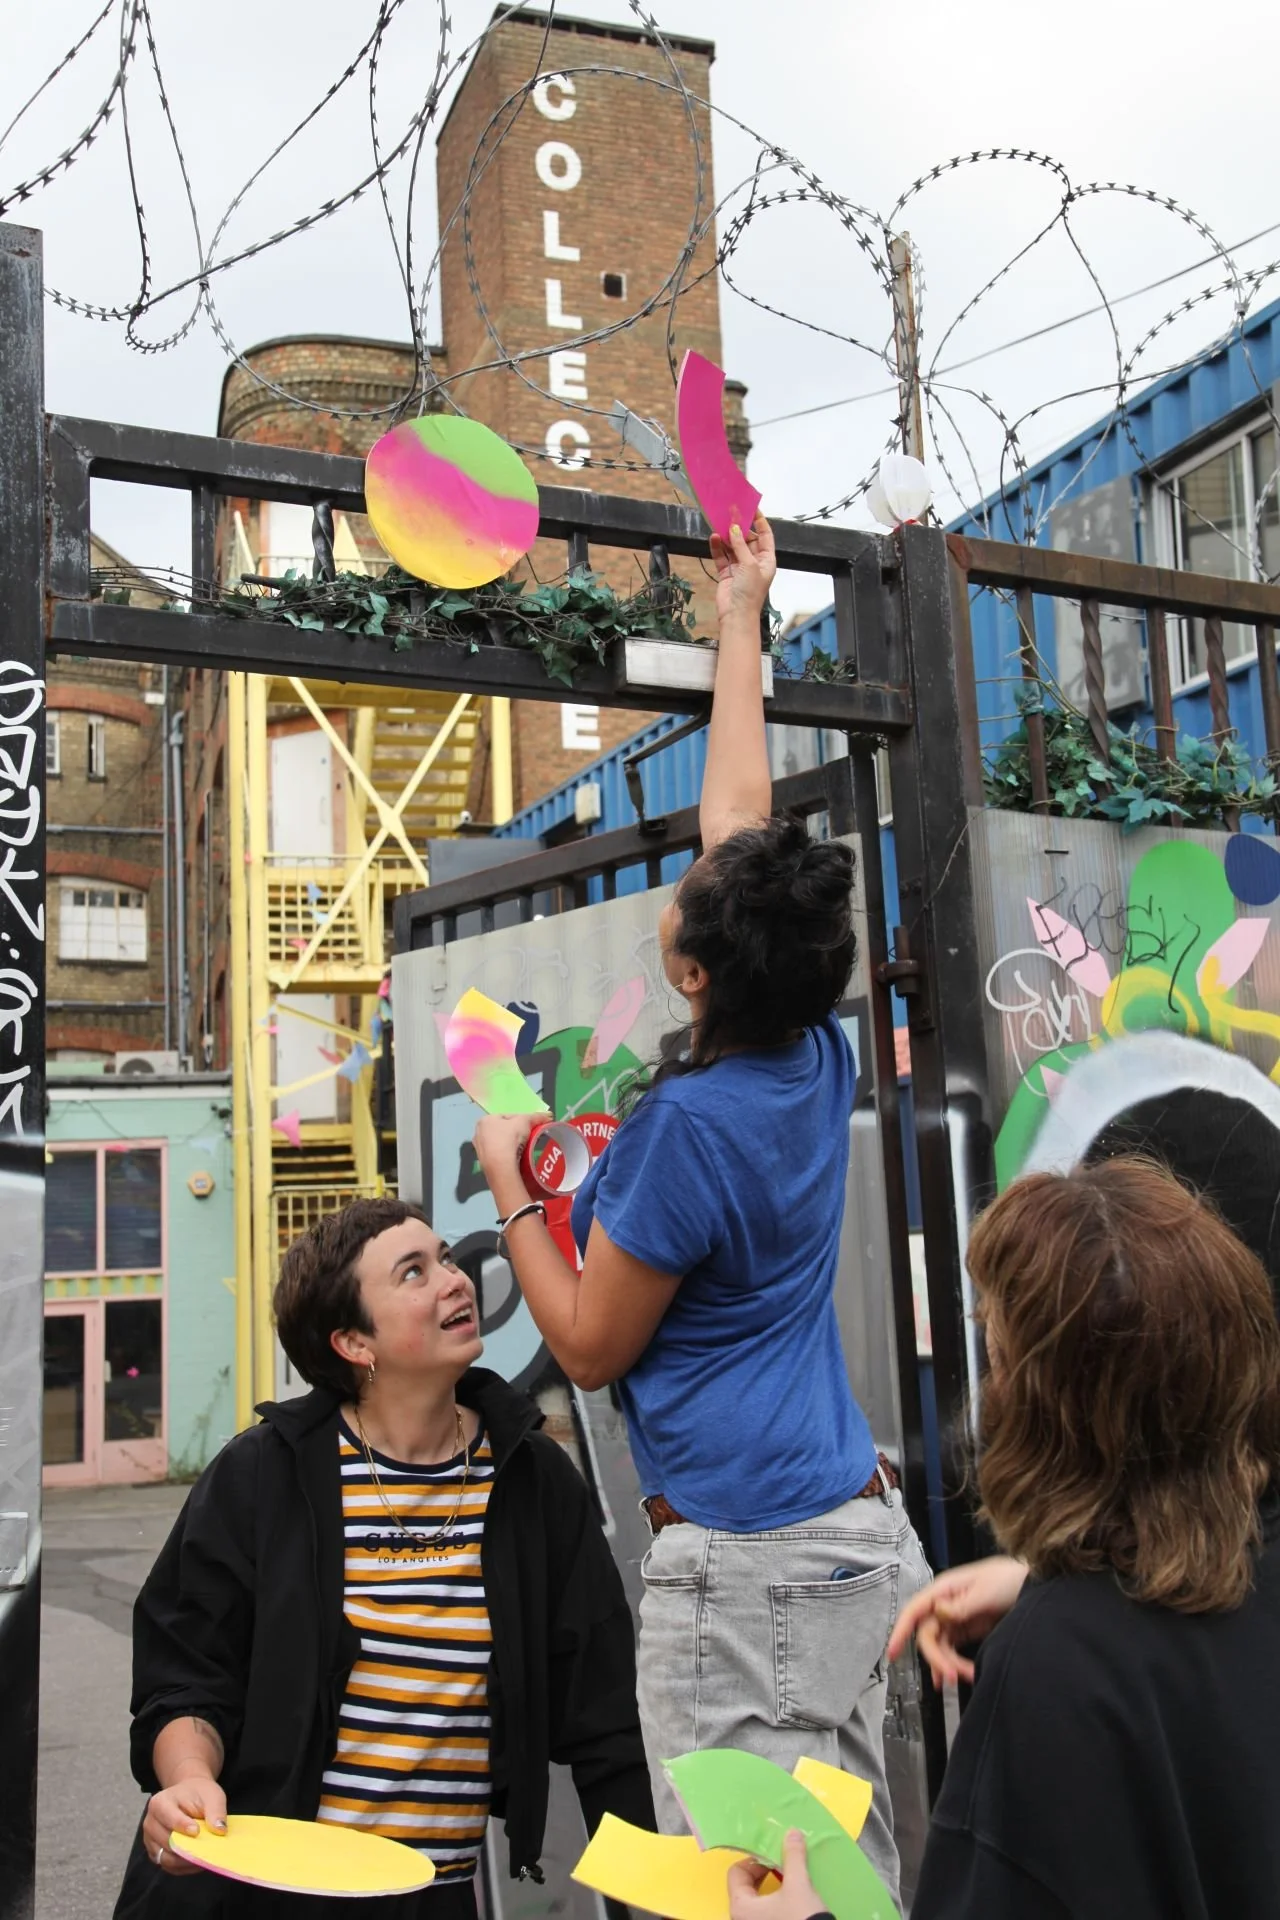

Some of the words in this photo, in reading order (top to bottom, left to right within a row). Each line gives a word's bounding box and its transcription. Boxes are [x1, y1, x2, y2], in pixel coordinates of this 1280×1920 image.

[533, 71, 601, 750] COLLECE
[364, 1531, 467, 1553] GUESS
[402, 1555, 449, 1563] ANGELES
